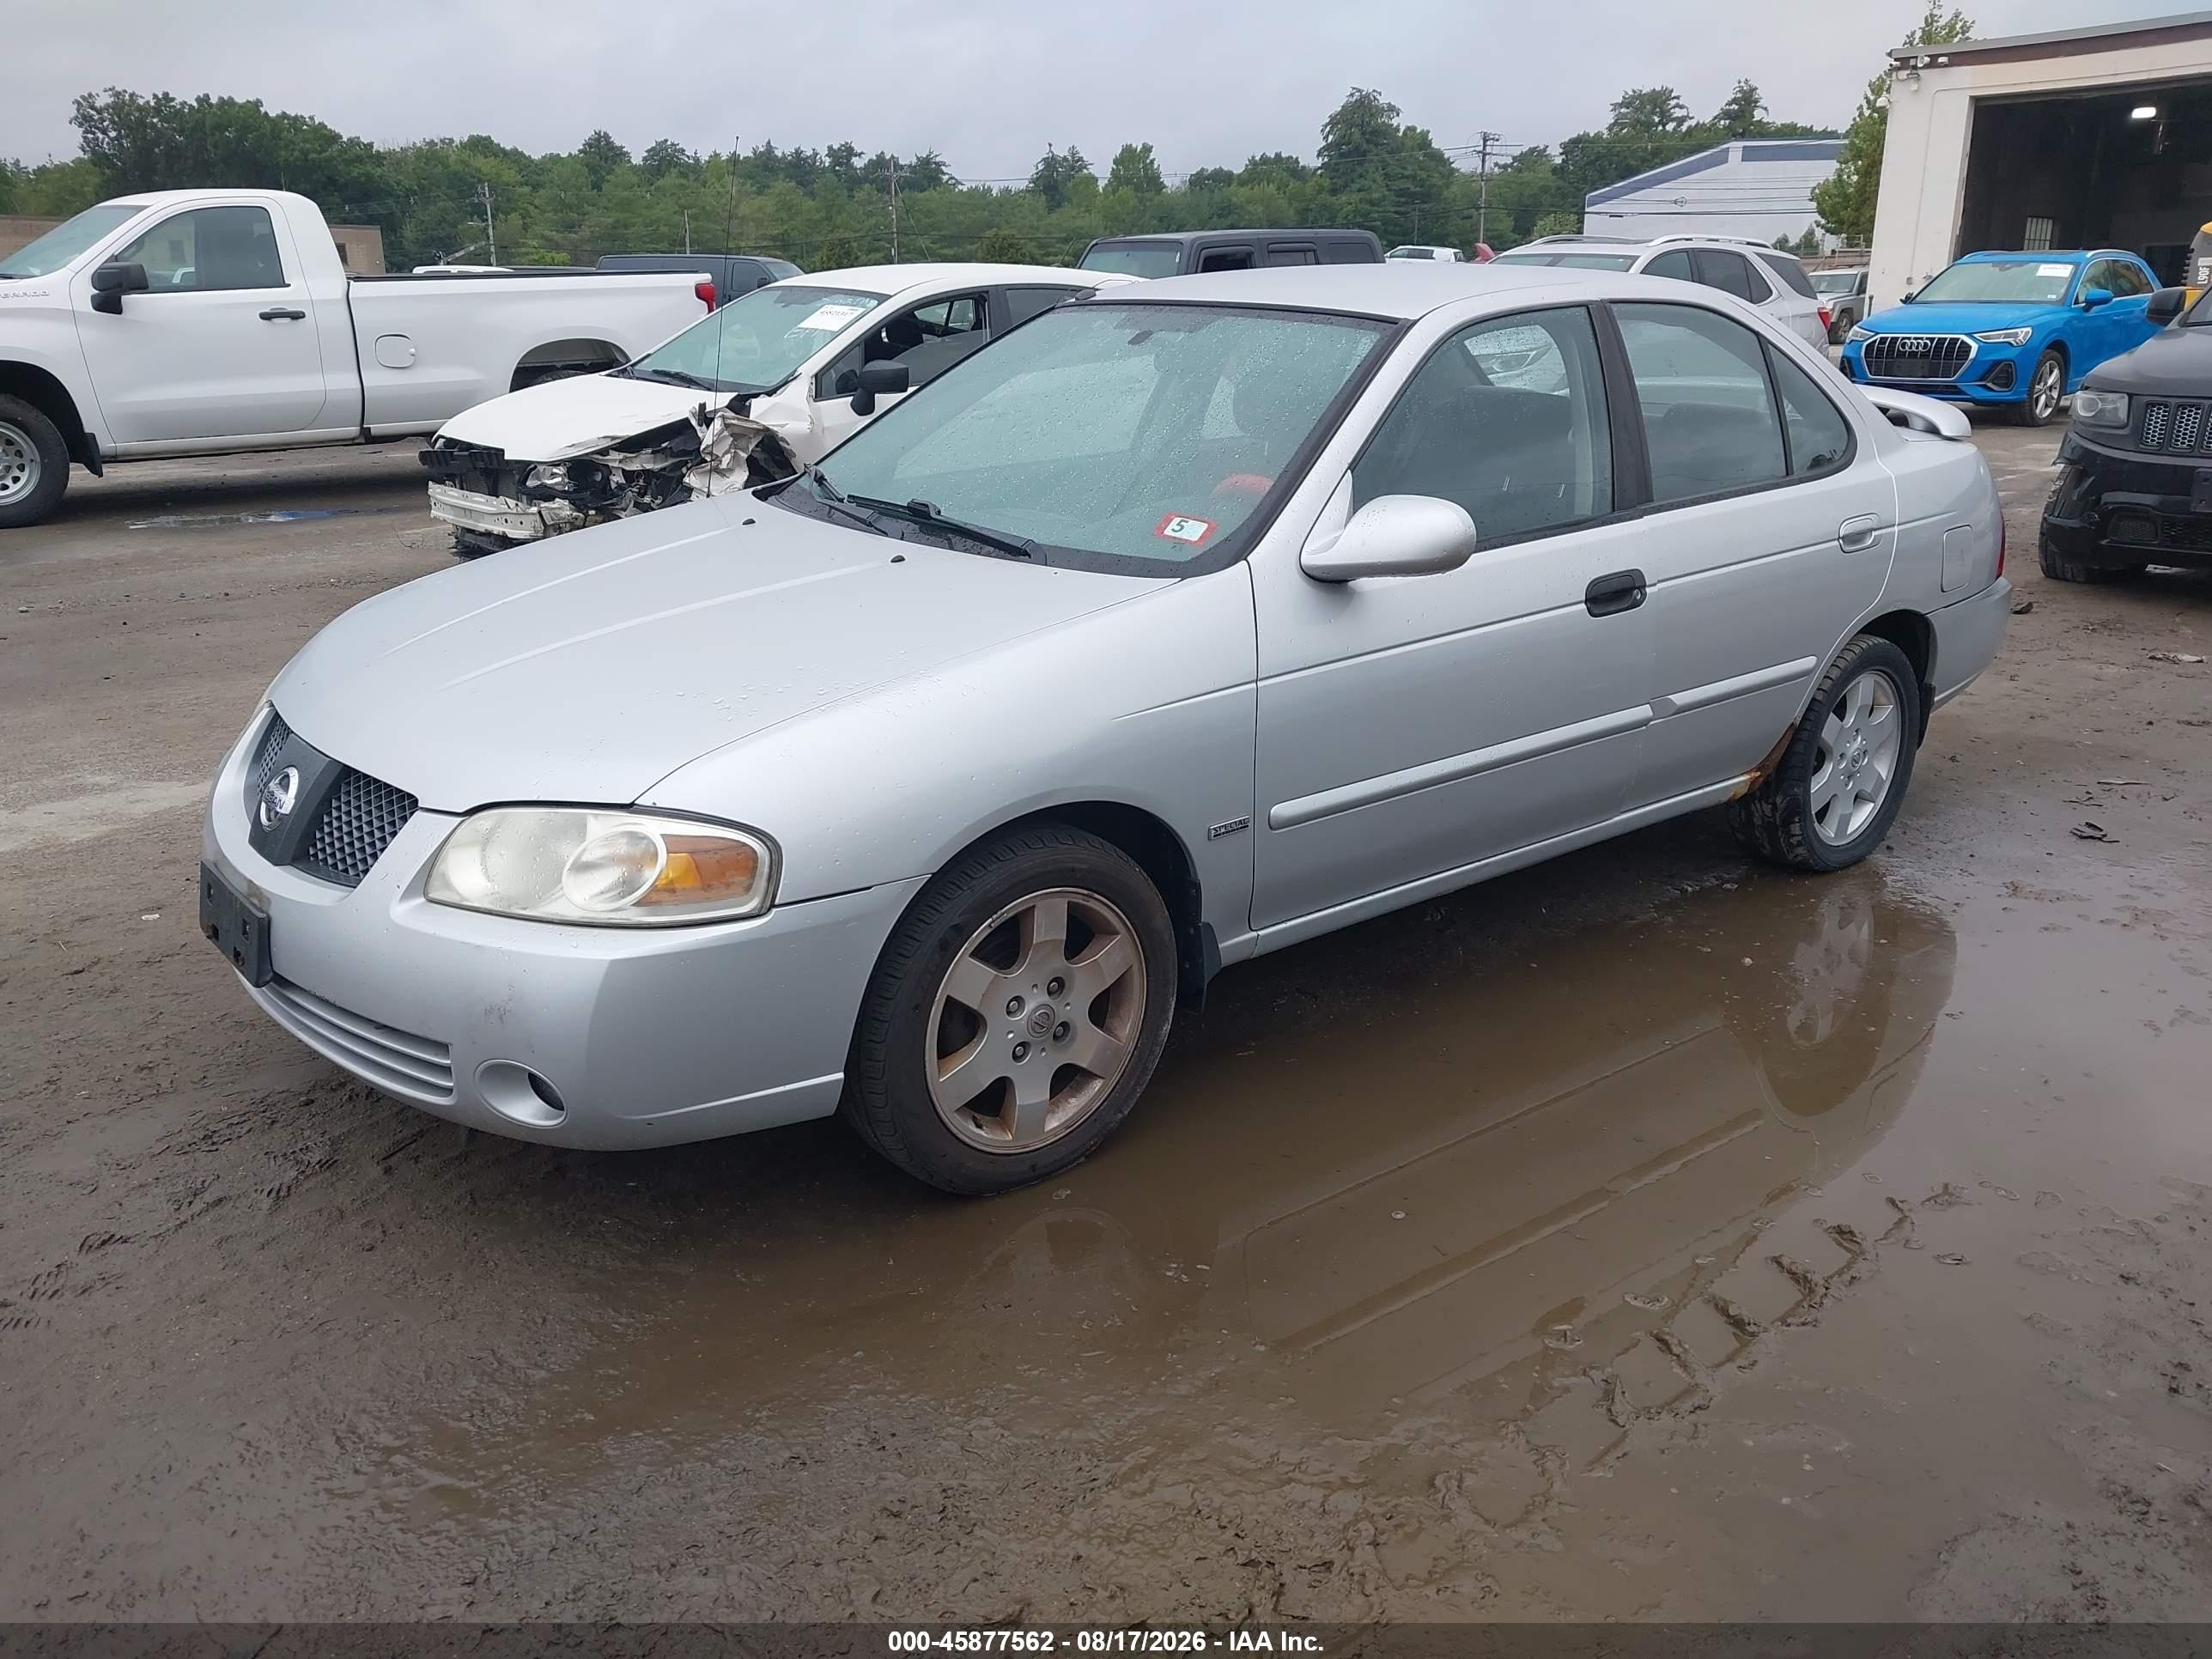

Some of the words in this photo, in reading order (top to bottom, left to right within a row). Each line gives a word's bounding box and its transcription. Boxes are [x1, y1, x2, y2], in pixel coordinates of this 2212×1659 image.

[2197, 267, 2210, 284] L90F
[0, 290, 50, 299] ERADO
[1171, 519, 1190, 533] 5
